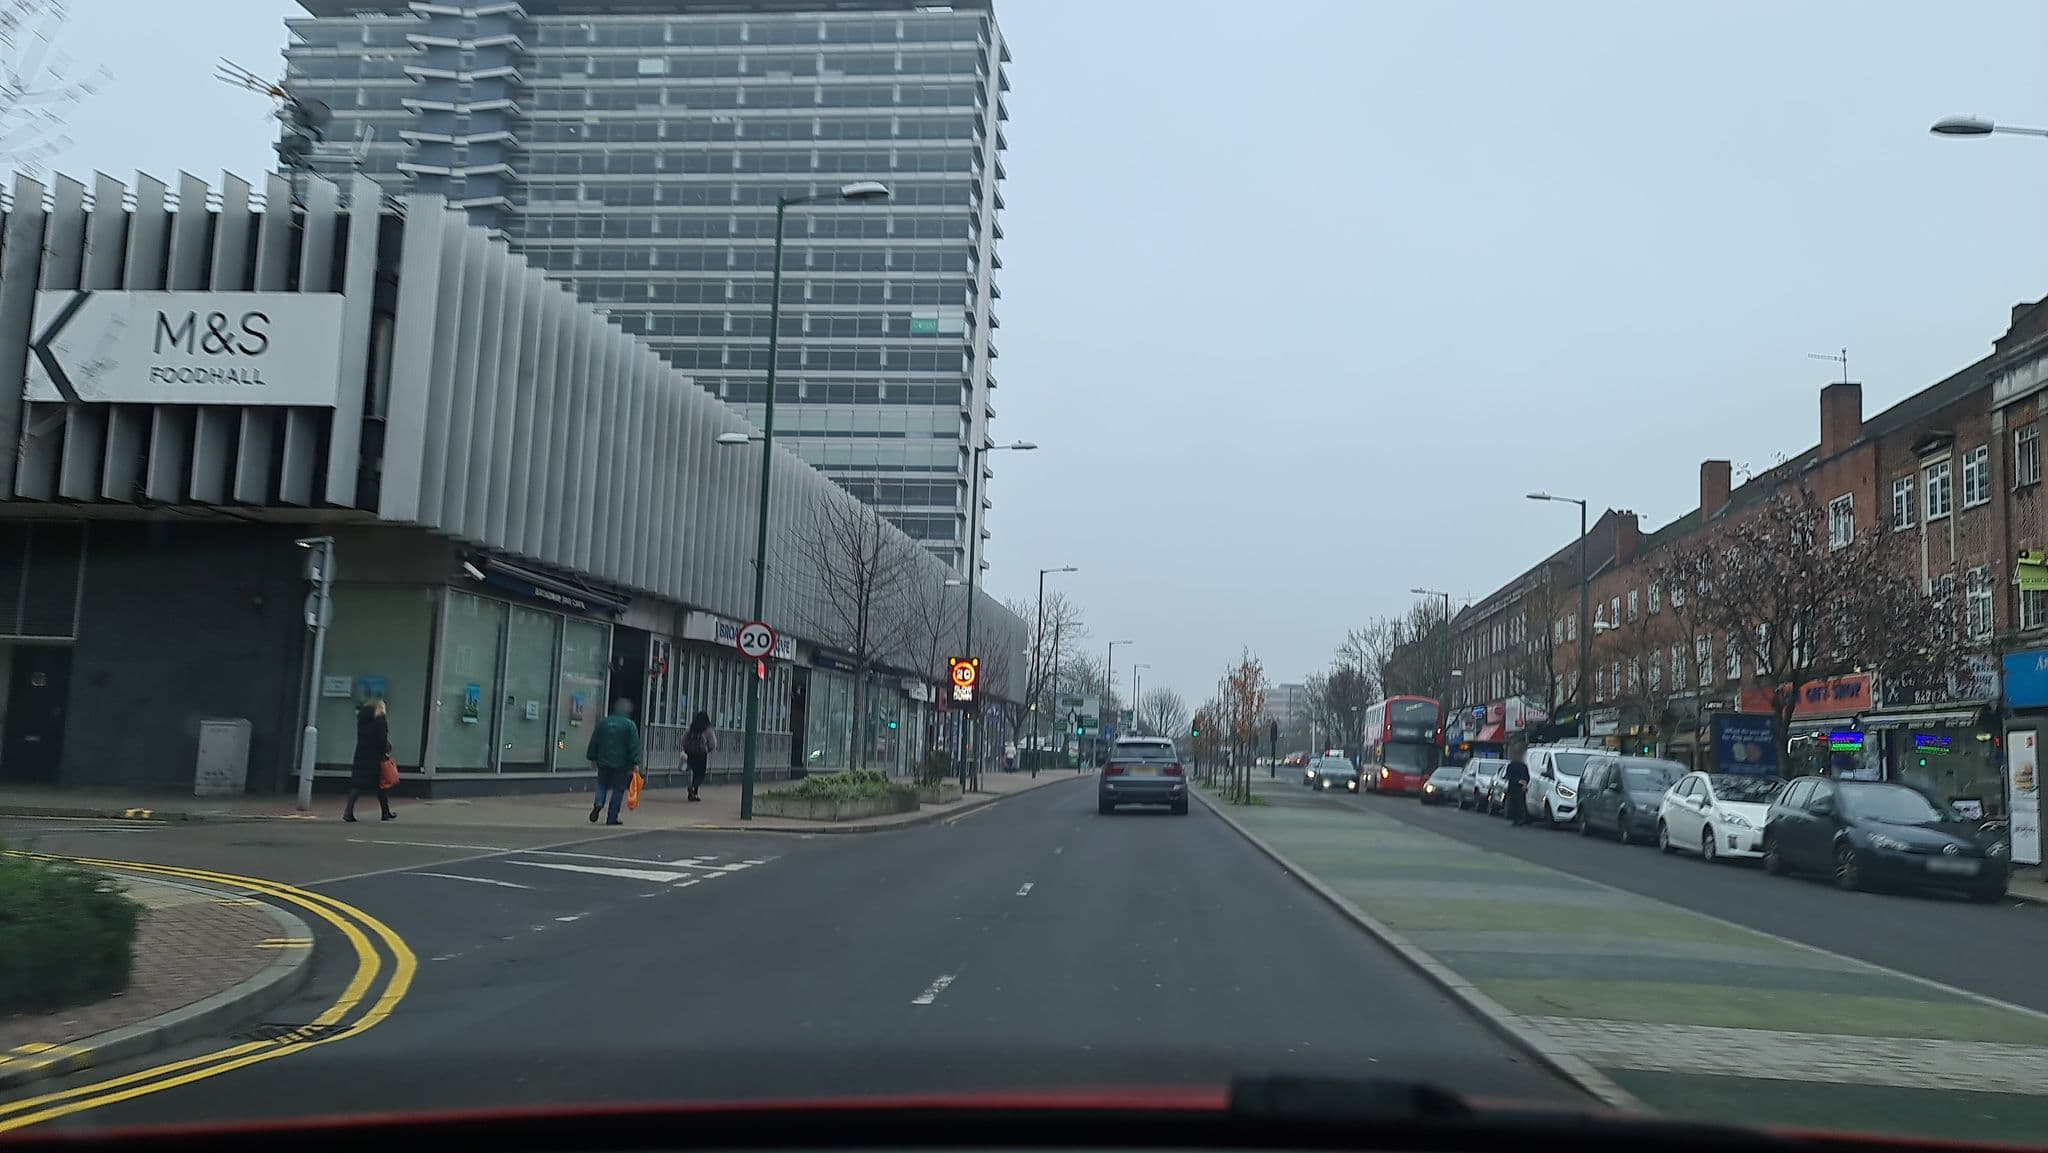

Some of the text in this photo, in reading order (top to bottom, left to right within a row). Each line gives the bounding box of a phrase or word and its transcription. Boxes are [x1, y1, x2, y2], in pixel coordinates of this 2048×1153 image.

[153, 310, 270, 356] M&S
[149, 366, 266, 385] FOODHALL
[743, 632, 770, 649] 20
